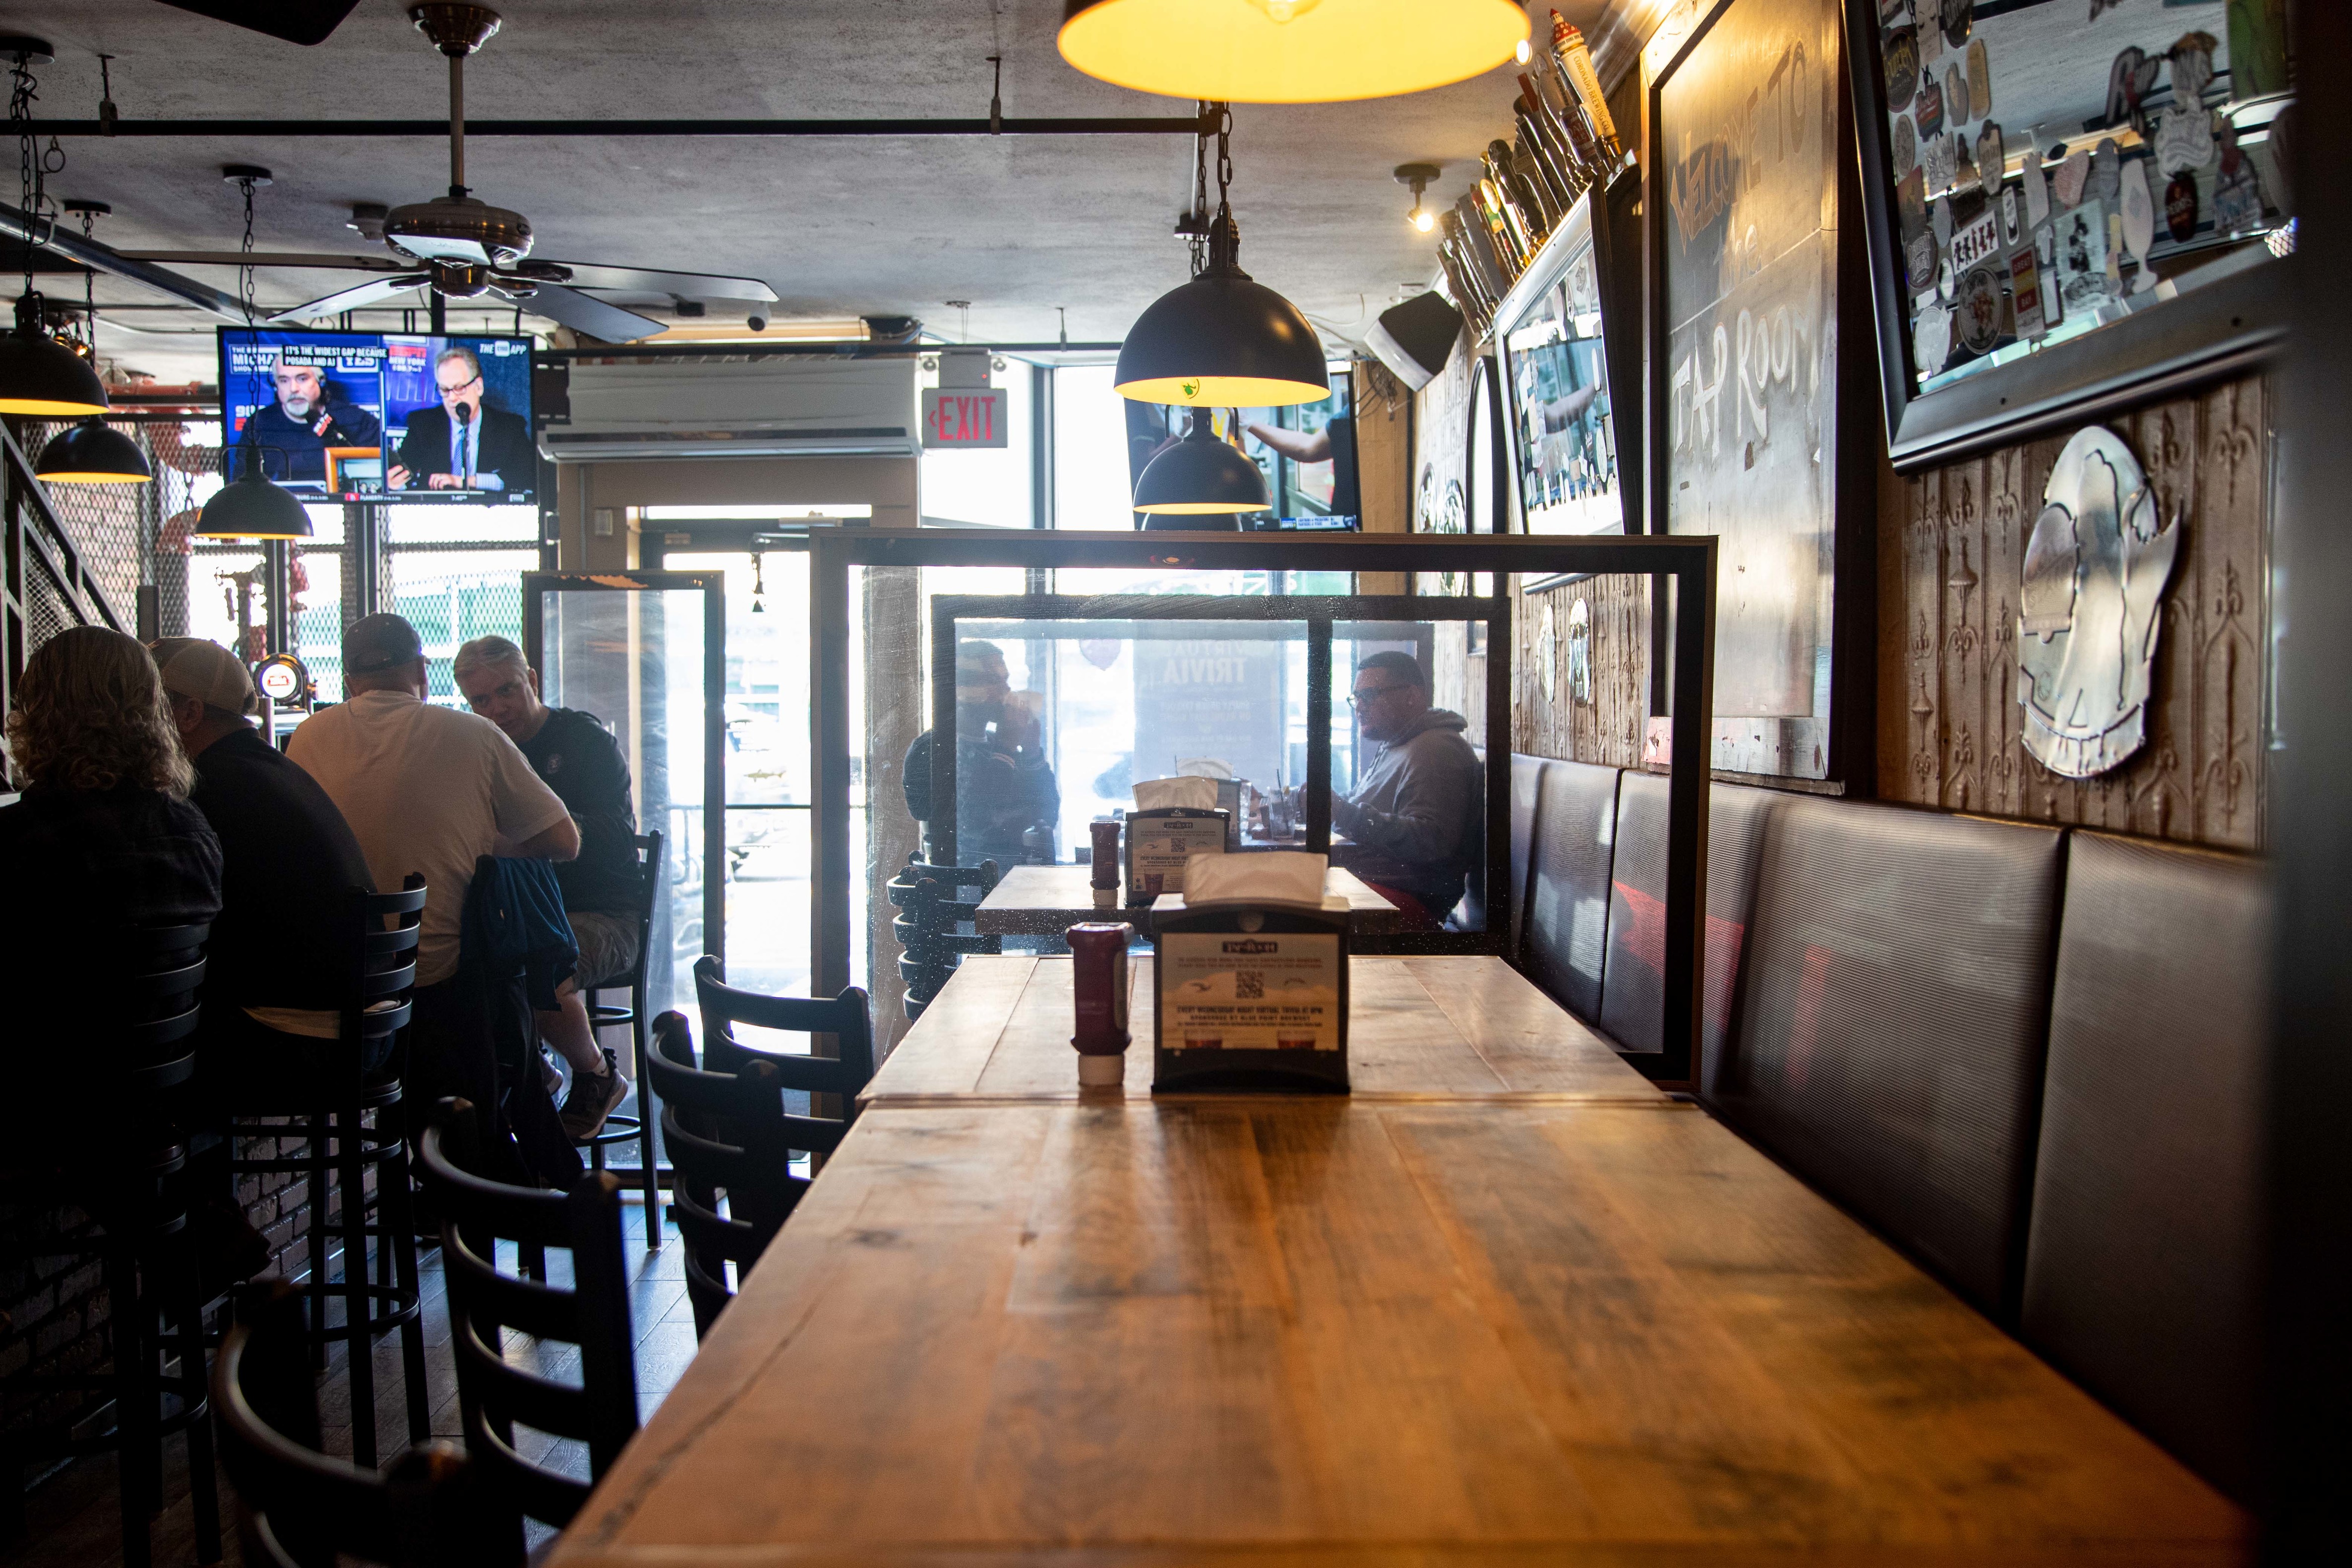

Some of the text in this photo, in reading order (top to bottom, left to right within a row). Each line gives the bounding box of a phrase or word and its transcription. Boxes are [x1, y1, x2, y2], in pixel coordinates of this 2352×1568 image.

[1573, 56, 1611, 132] CORONADO BREWING CO.
[1670, 40, 1807, 258] WELCOME TO
[285, 346, 300, 355] IT'S
[301, 347, 313, 356] THE
[314, 347, 341, 357] WIDEST
[356, 348, 388, 358] BECAUSE
[285, 356, 336, 366] POSADA AND AJ
[389, 357, 426, 366] NEW YORK
[480, 343, 494, 354] THE
[510, 345, 527, 355] APP
[1672, 278, 1819, 462] TAP ROOM
[939, 396, 996, 440] EXIT
